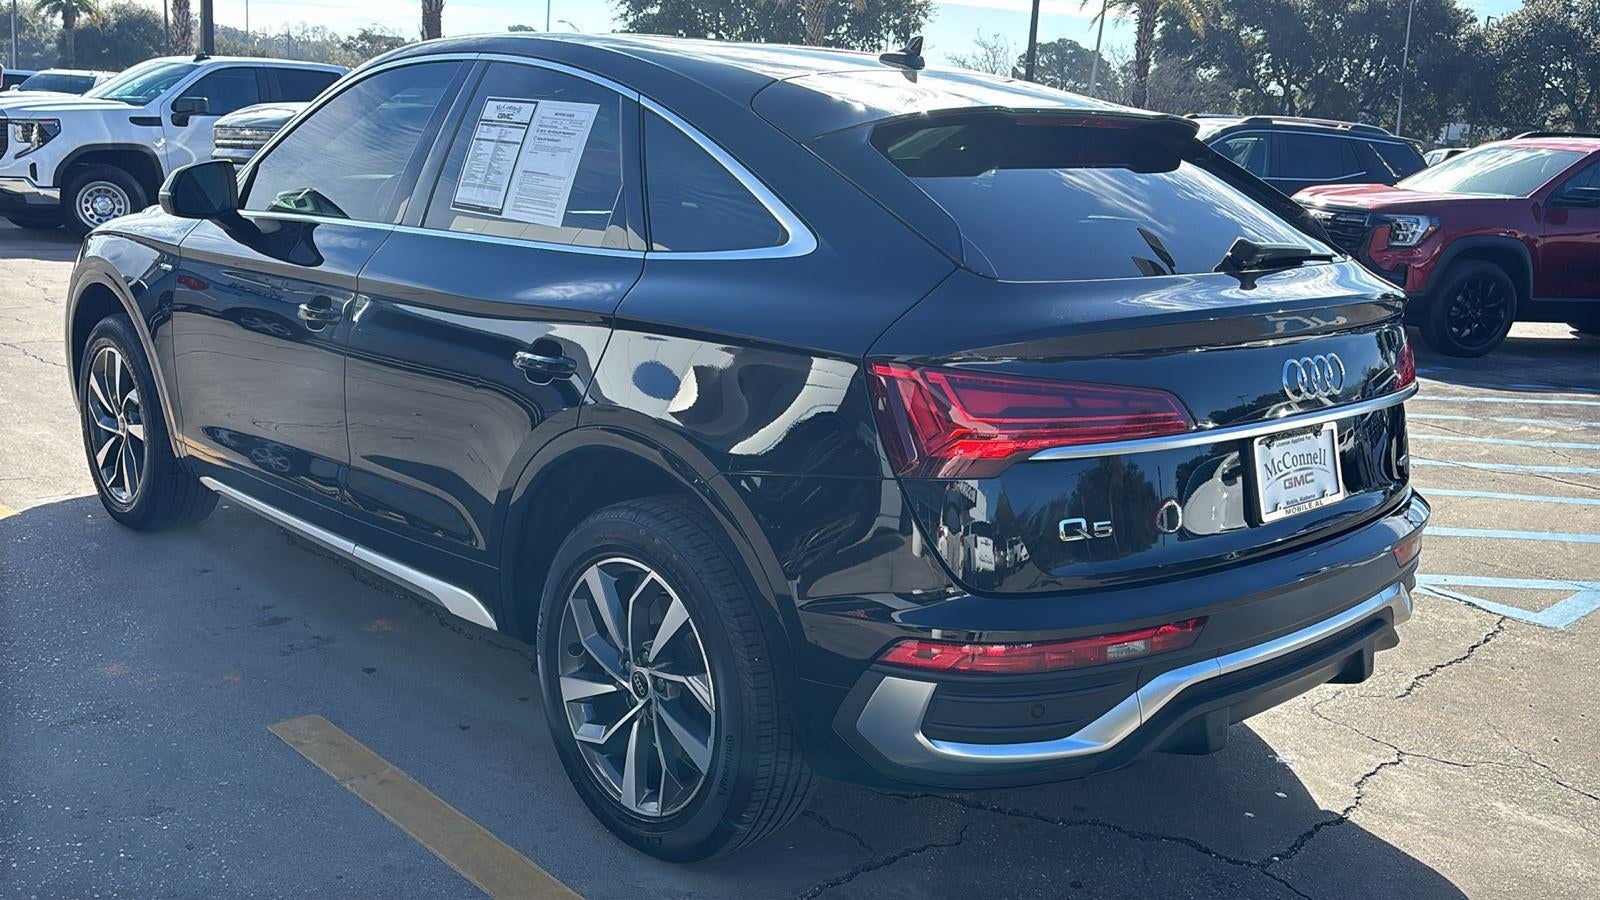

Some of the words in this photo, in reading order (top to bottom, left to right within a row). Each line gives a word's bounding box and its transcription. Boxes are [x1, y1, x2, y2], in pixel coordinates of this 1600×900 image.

[497, 112, 515, 120] GMC
[1263, 447, 1326, 481] McConnell
[1283, 472, 1315, 490] GMC
[1058, 517, 1113, 541] Q5
